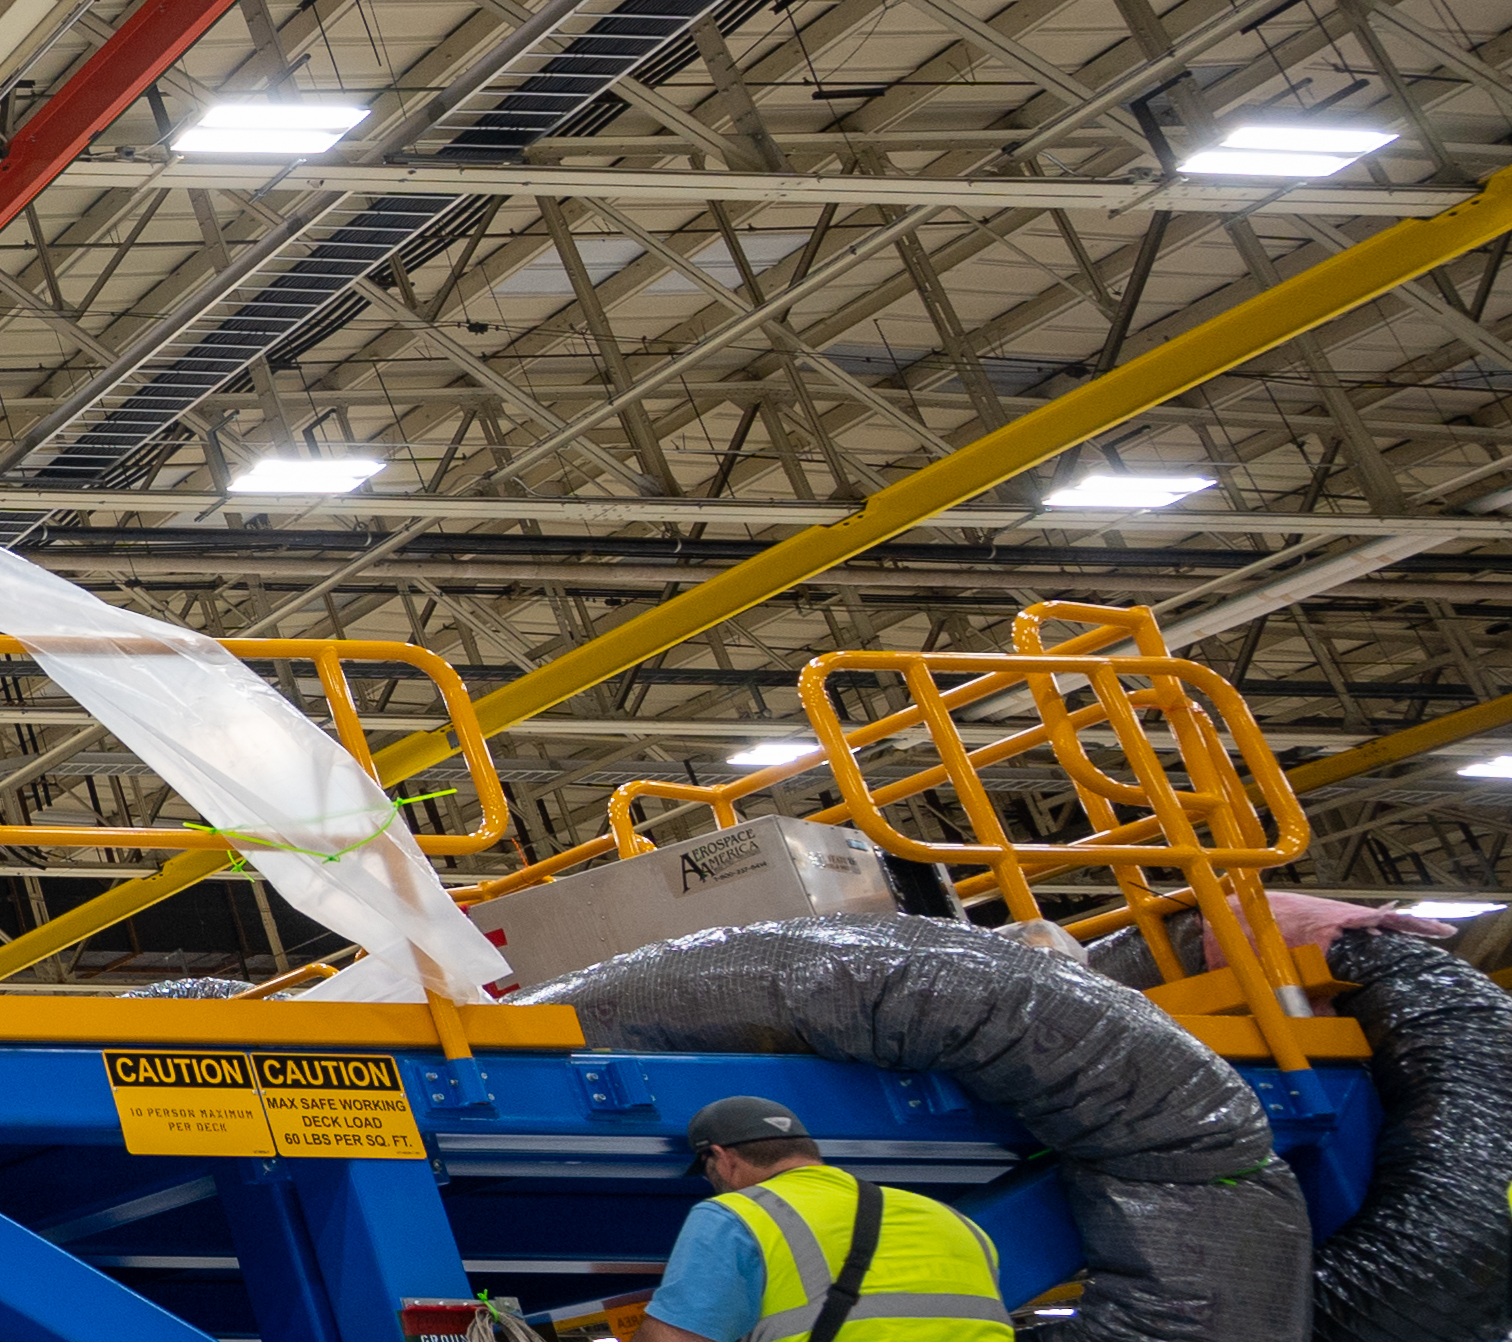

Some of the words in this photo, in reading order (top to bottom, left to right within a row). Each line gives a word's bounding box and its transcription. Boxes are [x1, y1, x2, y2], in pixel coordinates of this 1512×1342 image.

[700, 840, 759, 882] AMERICA
[116, 1057, 244, 1084] CAUTION
[263, 1060, 392, 1087] CAUTION
[266, 1097, 299, 1110] MAX
[301, 1098, 338, 1111] SAFE
[340, 1099, 406, 1112] WORKING
[130, 1108, 145, 1118] 10
[147, 1108, 196, 1118] PERSON
[200, 1109, 254, 1119] MAXIMUM
[168, 1122, 192, 1132] PER
[196, 1123, 227, 1133] DECK
[302, 1115, 341, 1128] DECK
[344, 1116, 383, 1129] LOAD
[284, 1132, 300, 1145] 60
[303, 1133, 331, 1146] LBS
[334, 1134, 363, 1147] PER
[365, 1135, 391, 1149] SQ.
[393, 1135, 413, 1148] FT.
